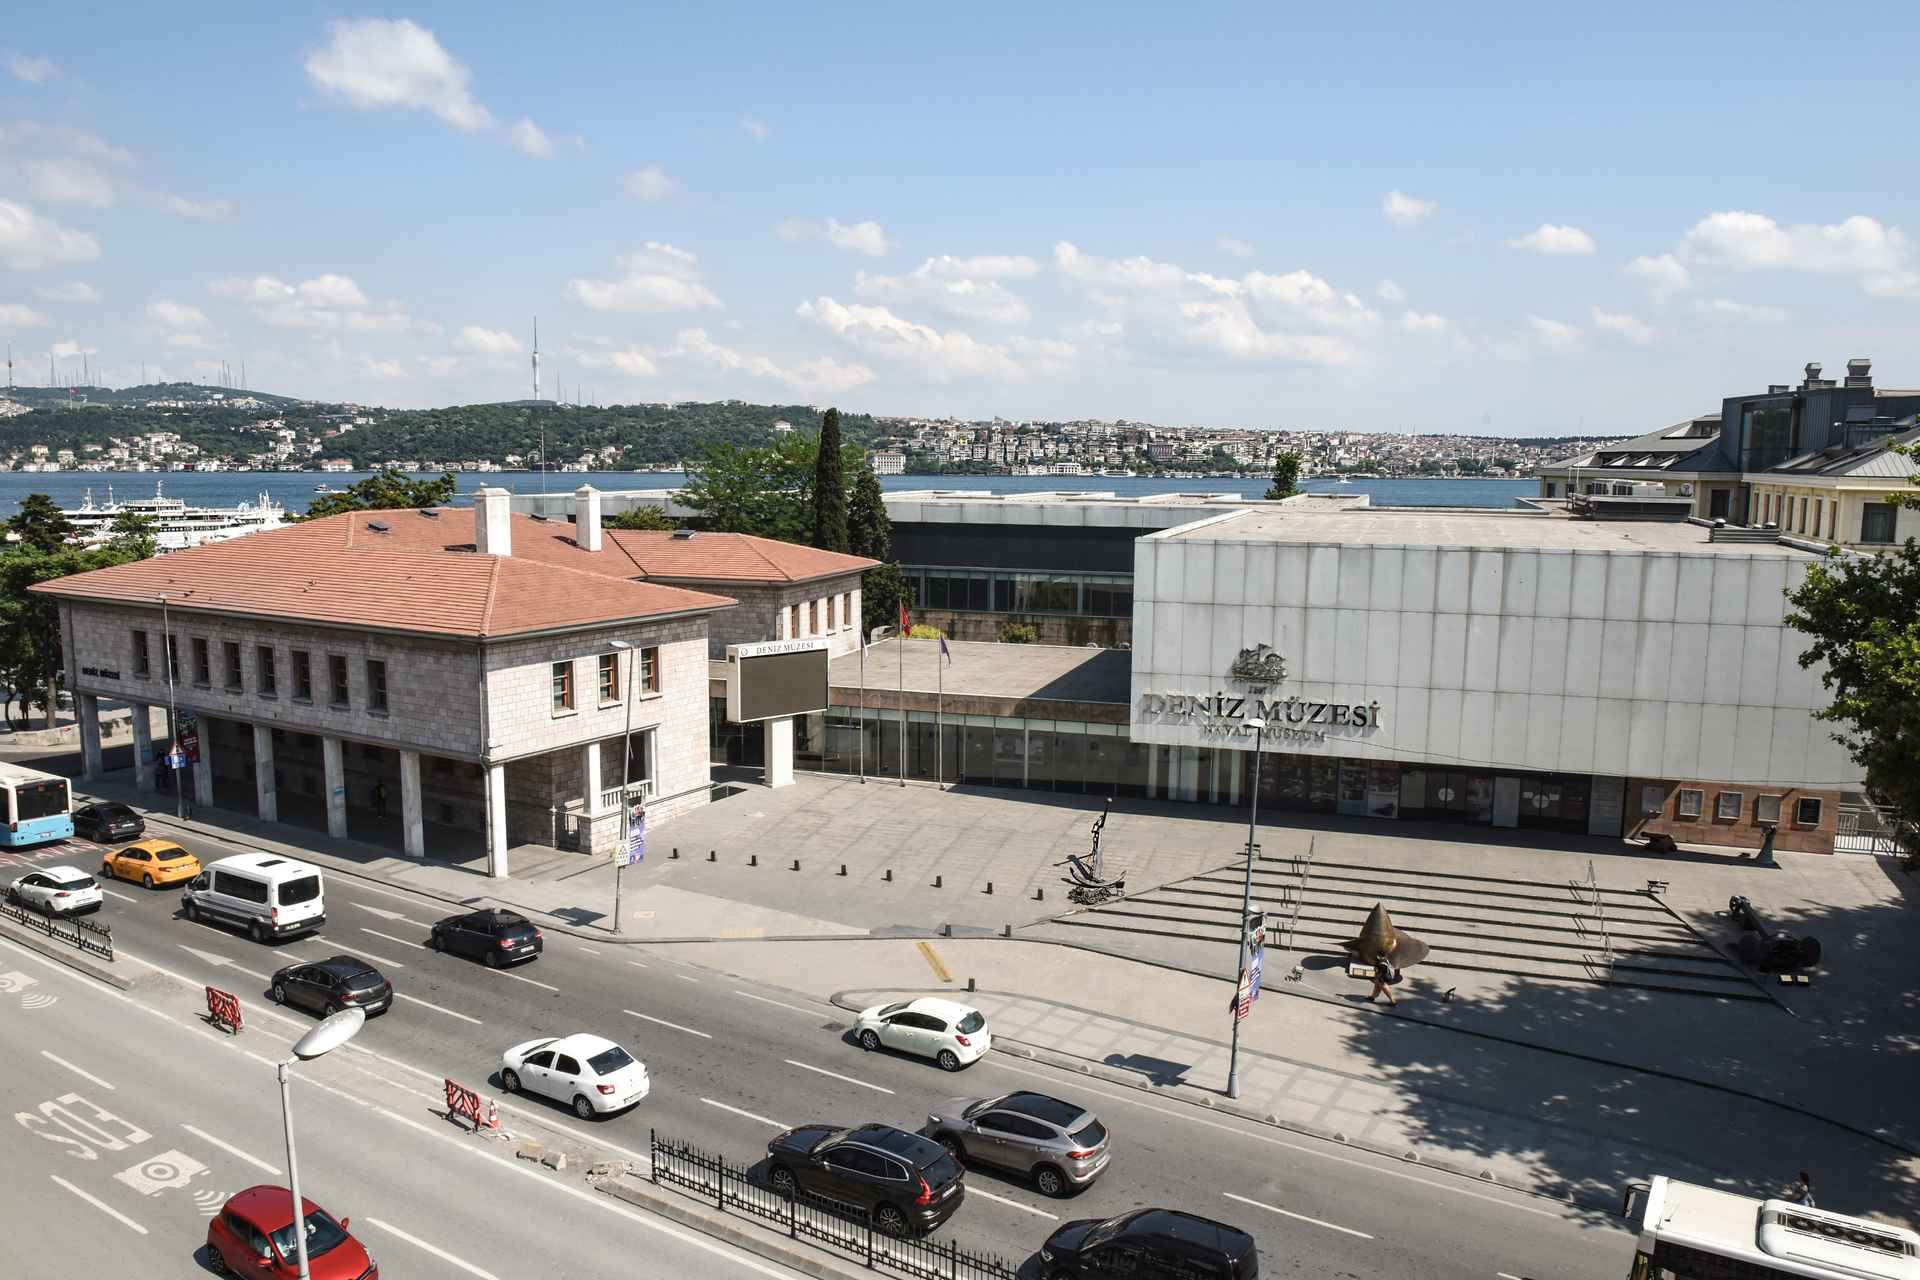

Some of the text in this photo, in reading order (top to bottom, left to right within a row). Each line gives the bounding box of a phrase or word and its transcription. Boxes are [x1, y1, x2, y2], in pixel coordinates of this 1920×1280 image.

[1142, 691, 1381, 728] DENİZ MÜZESİ
[1203, 724, 1325, 743] NAVAL MUSEUM
